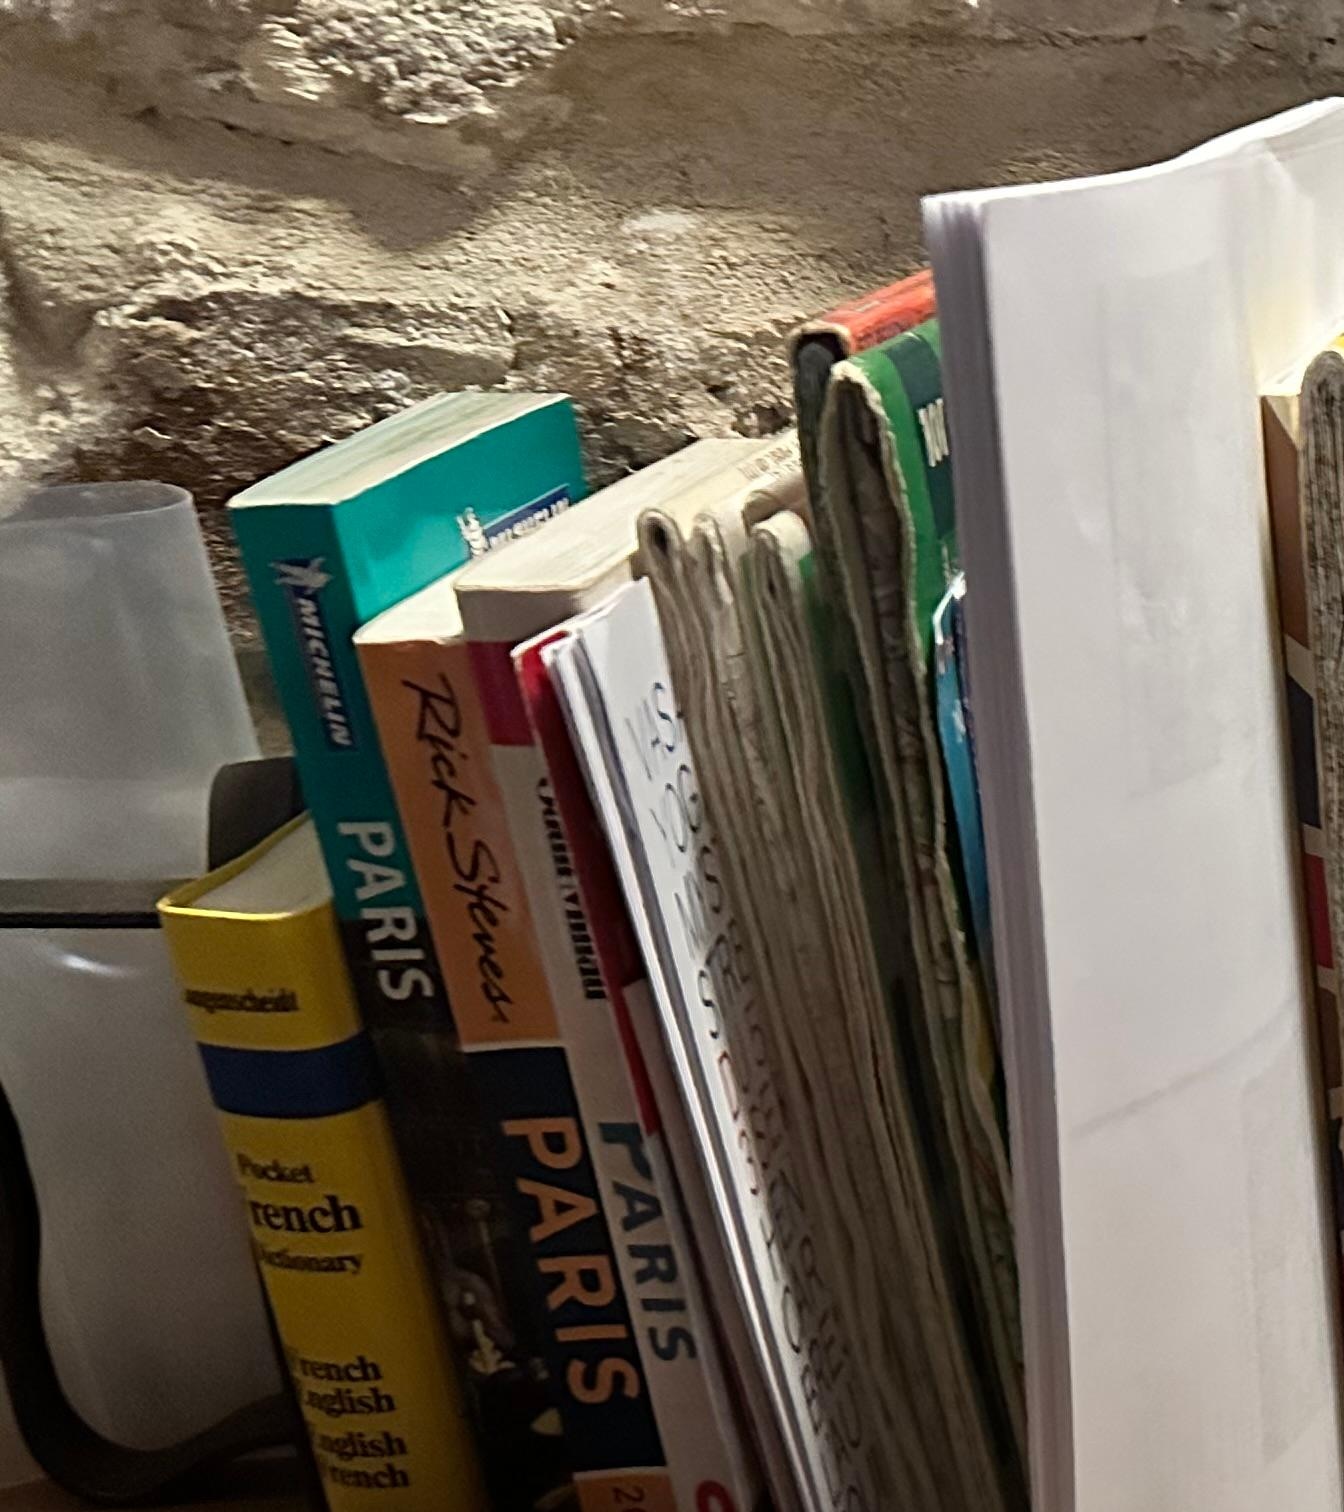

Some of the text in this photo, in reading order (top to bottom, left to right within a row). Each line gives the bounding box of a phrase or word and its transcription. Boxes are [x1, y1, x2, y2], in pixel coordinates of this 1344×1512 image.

[297, 597, 353, 747] MICHELIN
[402, 673, 476, 829] Rick
[337, 820, 435, 1001] PARIS
[250, 1194, 364, 1234] rench
[502, 1117, 640, 1404] PARIS
[598, 1122, 699, 1362] PARIS
[300, 1355, 383, 1382] rench
[305, 1387, 397, 1418] nglish
[319, 1431, 408, 1461] nglish
[329, 1463, 411, 1489] rench
